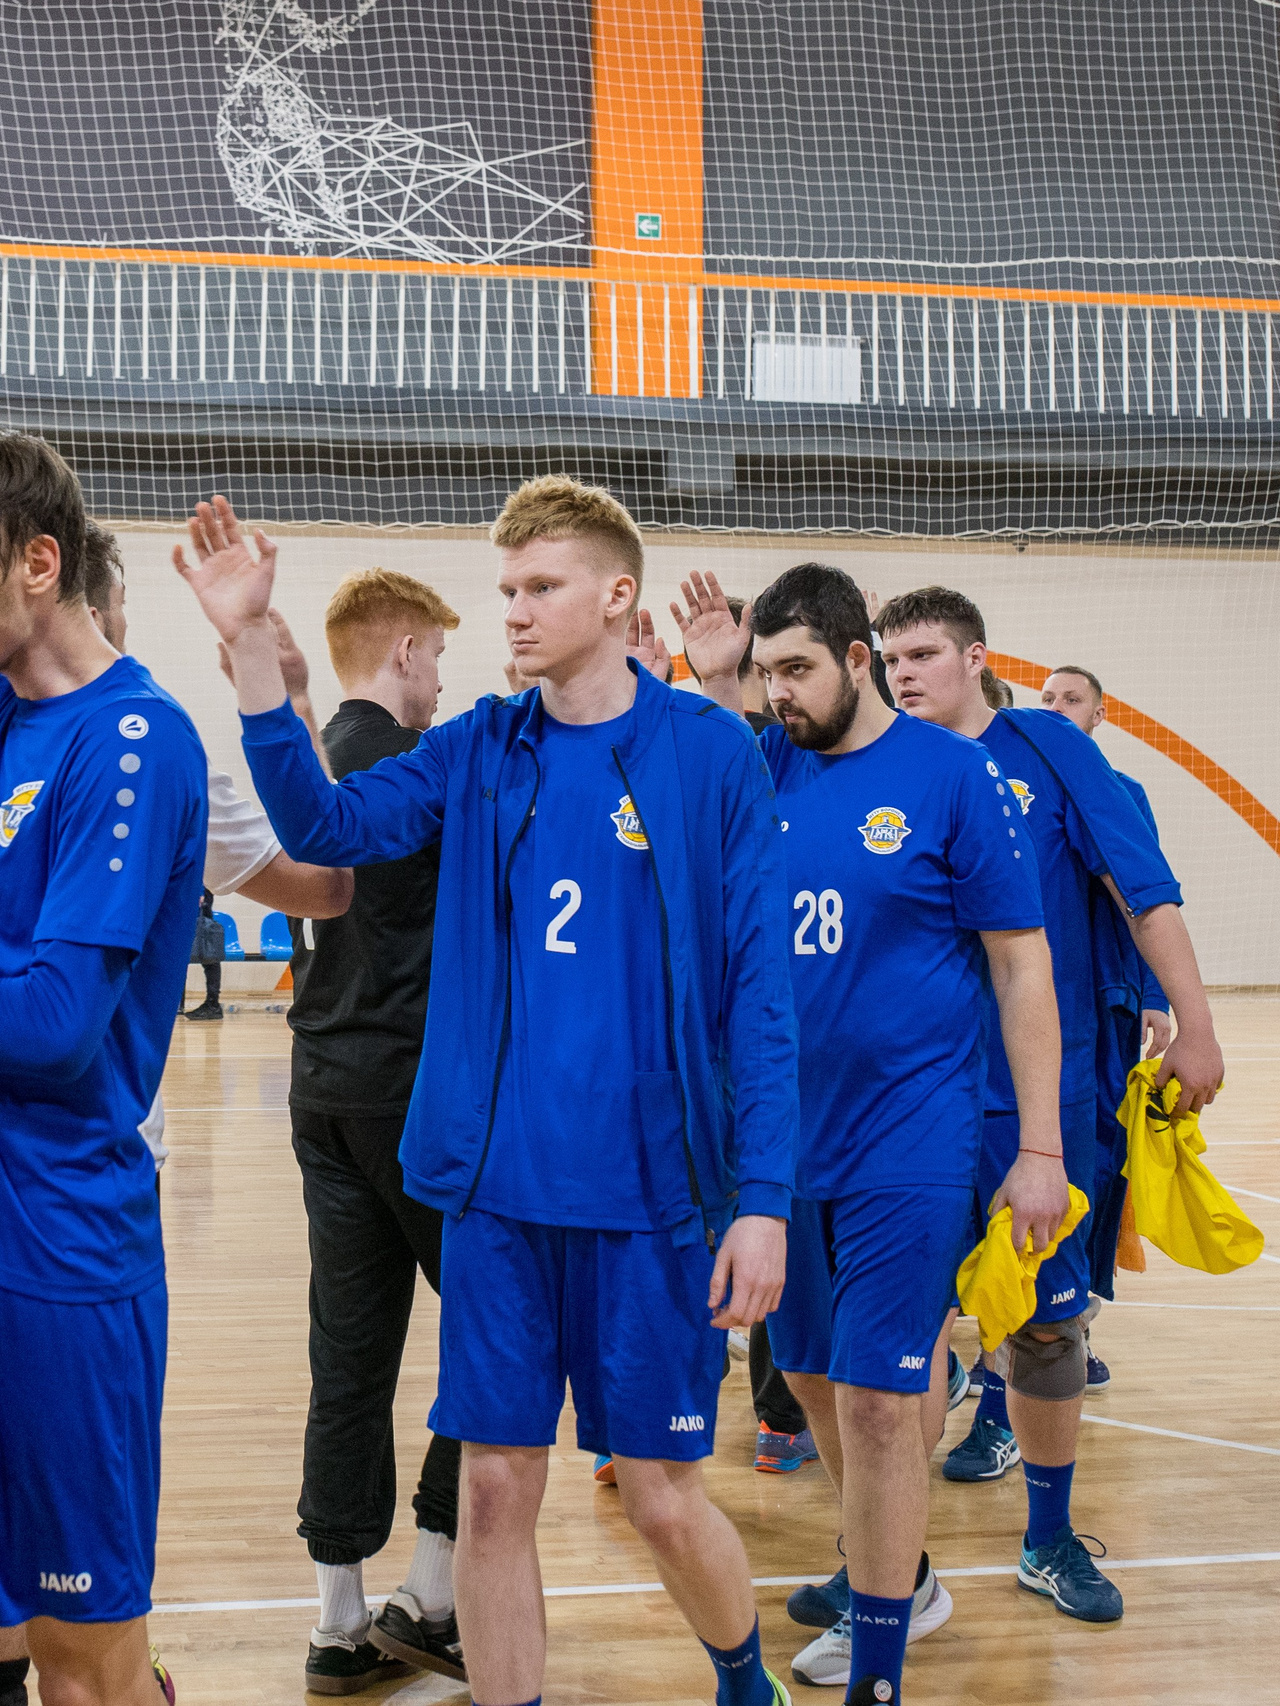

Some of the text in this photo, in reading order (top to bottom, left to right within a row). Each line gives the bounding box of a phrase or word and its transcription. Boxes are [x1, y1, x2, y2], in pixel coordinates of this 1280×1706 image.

[545, 879, 582, 954] 2
[793, 888, 844, 955] 28
[1050, 1288, 1076, 1305] JAKO
[669, 1415, 705, 1432] JAKO
[39, 1571, 93, 1594] JAKO
[855, 1612, 900, 1626] JAKO
